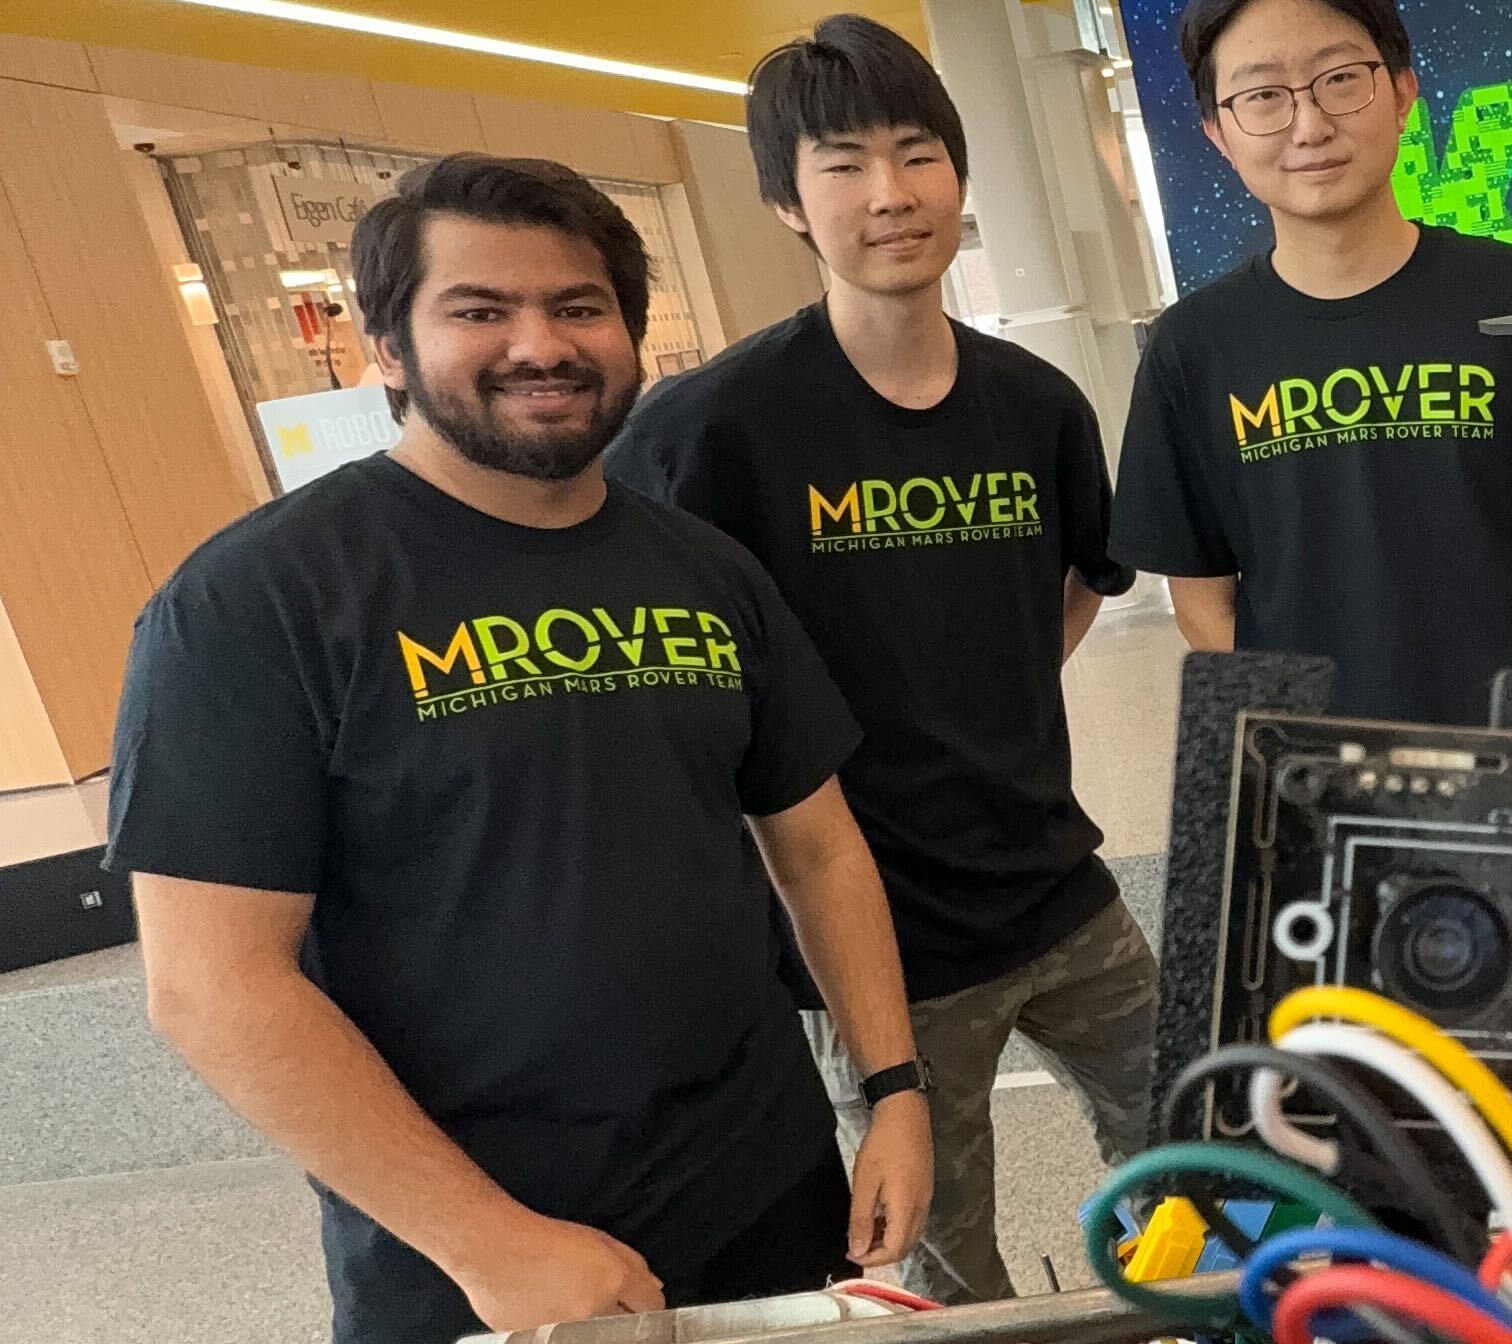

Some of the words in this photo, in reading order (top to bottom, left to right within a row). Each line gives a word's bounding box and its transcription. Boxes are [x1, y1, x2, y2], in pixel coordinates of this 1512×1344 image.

[290, 192, 338, 228] Eigen
[1228, 363, 1496, 447] MROVER
[319, 409, 395, 452] ROBO
[1240, 435, 1328, 465] MICHIGAN
[1336, 429, 1378, 445] MARS
[1386, 425, 1443, 440] ROVER
[1451, 424, 1495, 440] TEAM
[807, 471, 1040, 536] MROVER
[811, 536, 906, 554] MICHIGAN
[911, 531, 954, 547] MARS
[960, 527, 1011, 543] ROVER
[1012, 524, 1043, 539] TEAM
[397, 606, 742, 698] MROVER
[417, 681, 553, 722] MICHIGAN
[564, 676, 617, 694] MARS
[627, 670, 699, 688] ROVER
[706, 672, 743, 692] TEAM
